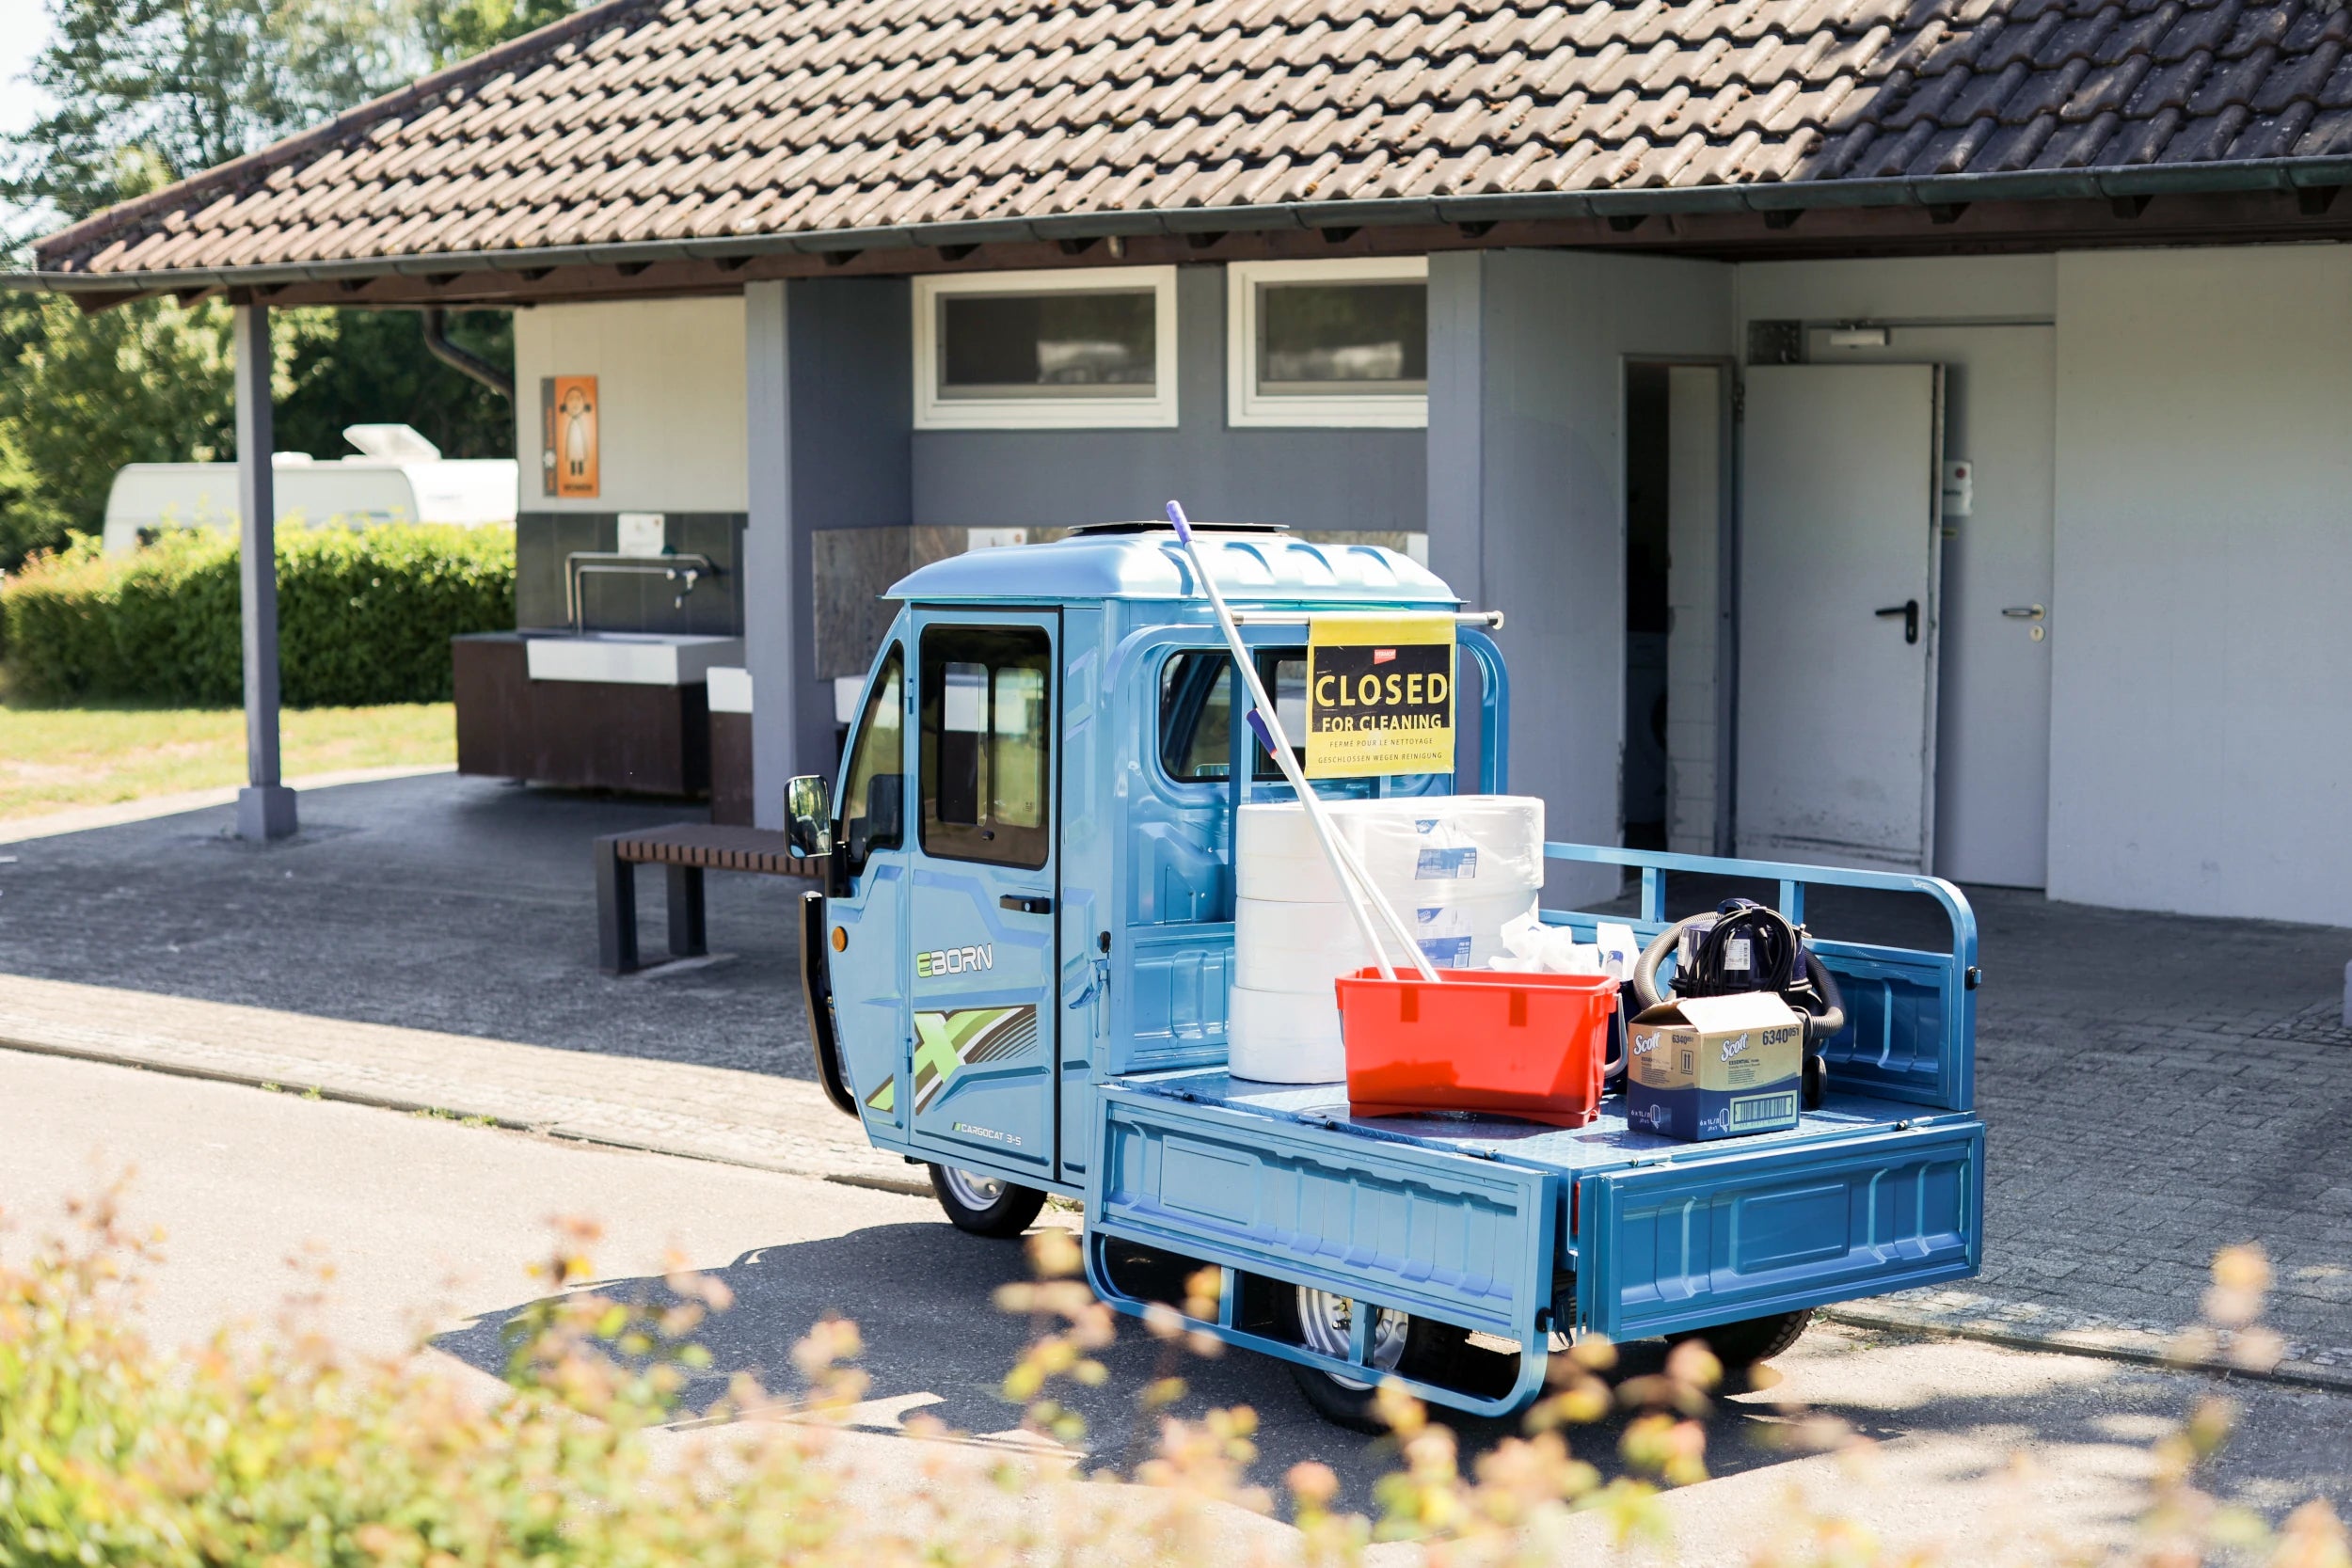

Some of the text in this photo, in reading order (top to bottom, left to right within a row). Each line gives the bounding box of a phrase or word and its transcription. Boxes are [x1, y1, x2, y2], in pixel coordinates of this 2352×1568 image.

[1315, 673, 1448, 707] CLOSED
[1322, 714, 1441, 732] FOR CLEANING
[1391, 737, 1433, 746] NETTOYAGE
[1318, 754, 1371, 764] GESCHLOSSEN
[916, 943, 993, 978] EBORN
[1633, 1031, 1661, 1055] Scott
[1720, 1032, 1749, 1063] Scott
[961, 1123, 1004, 1141] CARGOCAT
